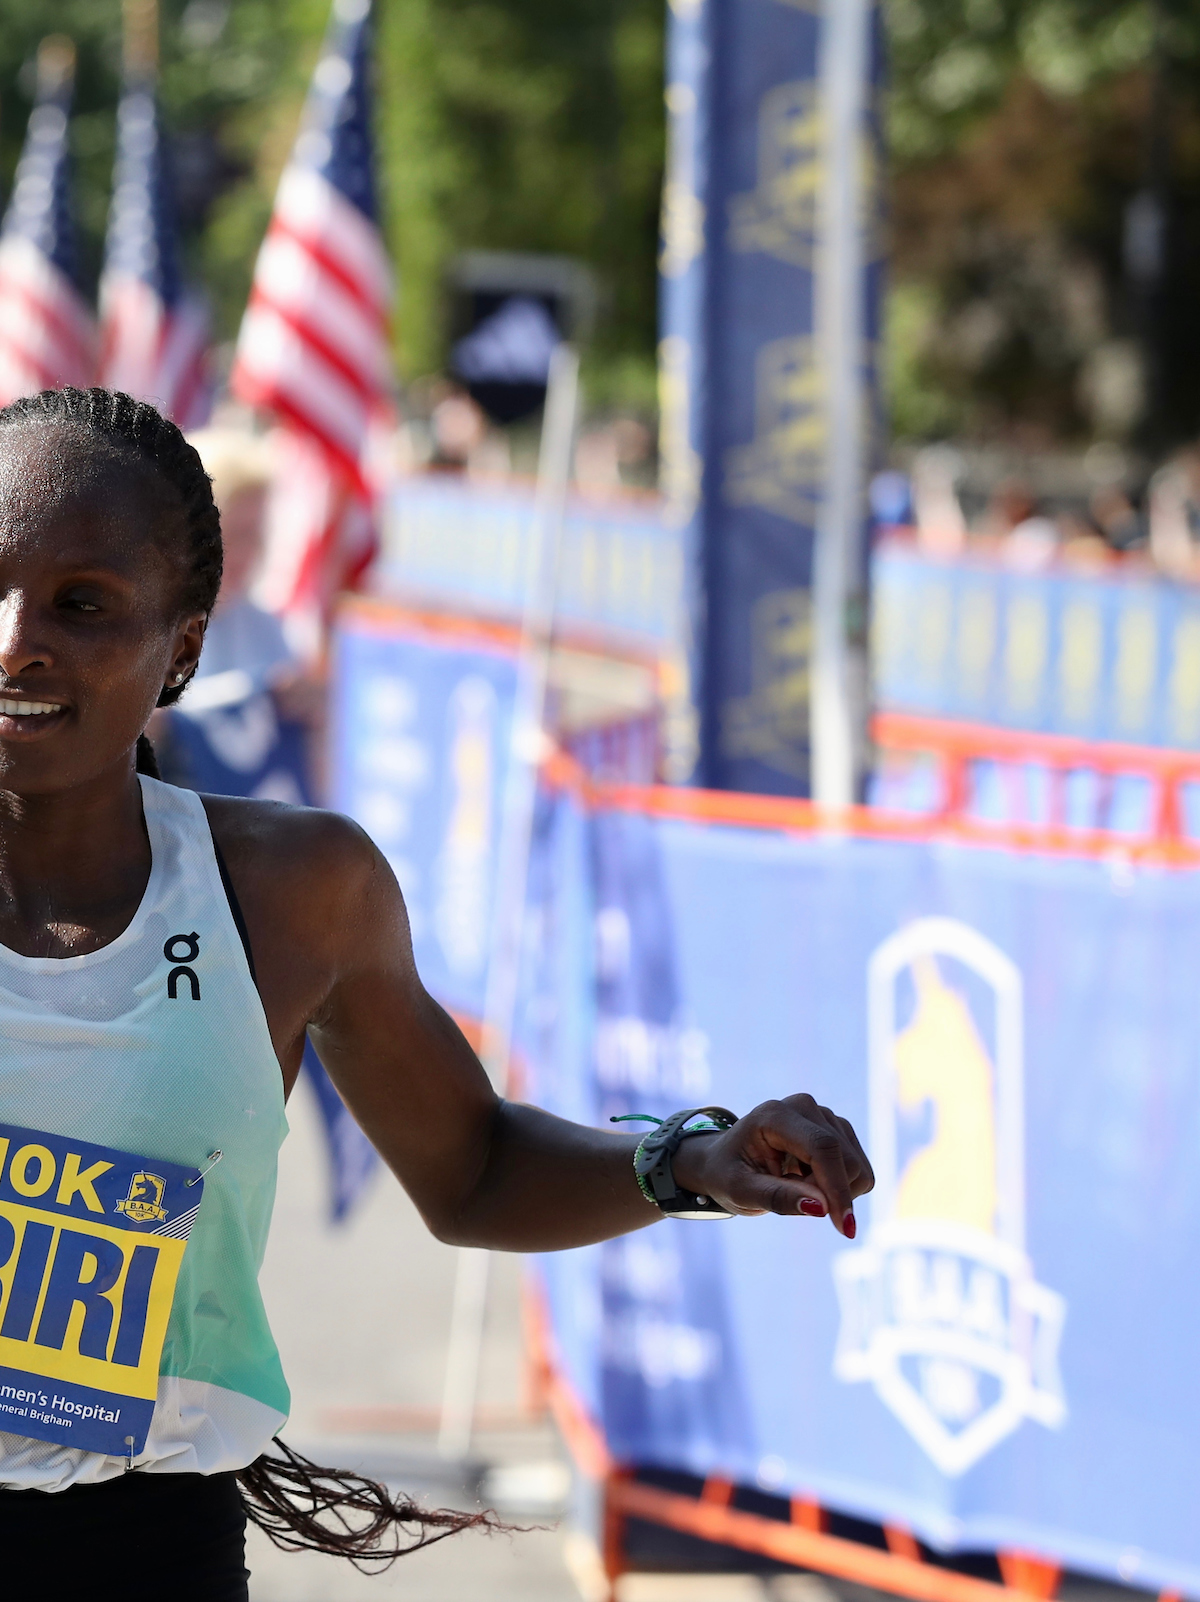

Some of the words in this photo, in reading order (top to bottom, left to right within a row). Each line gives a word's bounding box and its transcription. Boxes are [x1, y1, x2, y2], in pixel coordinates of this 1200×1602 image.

[130, 1202, 156, 1214] B.A.A.
[29, 1409, 73, 1428] Brigham
[51, 1395, 121, 1423] Hospital
